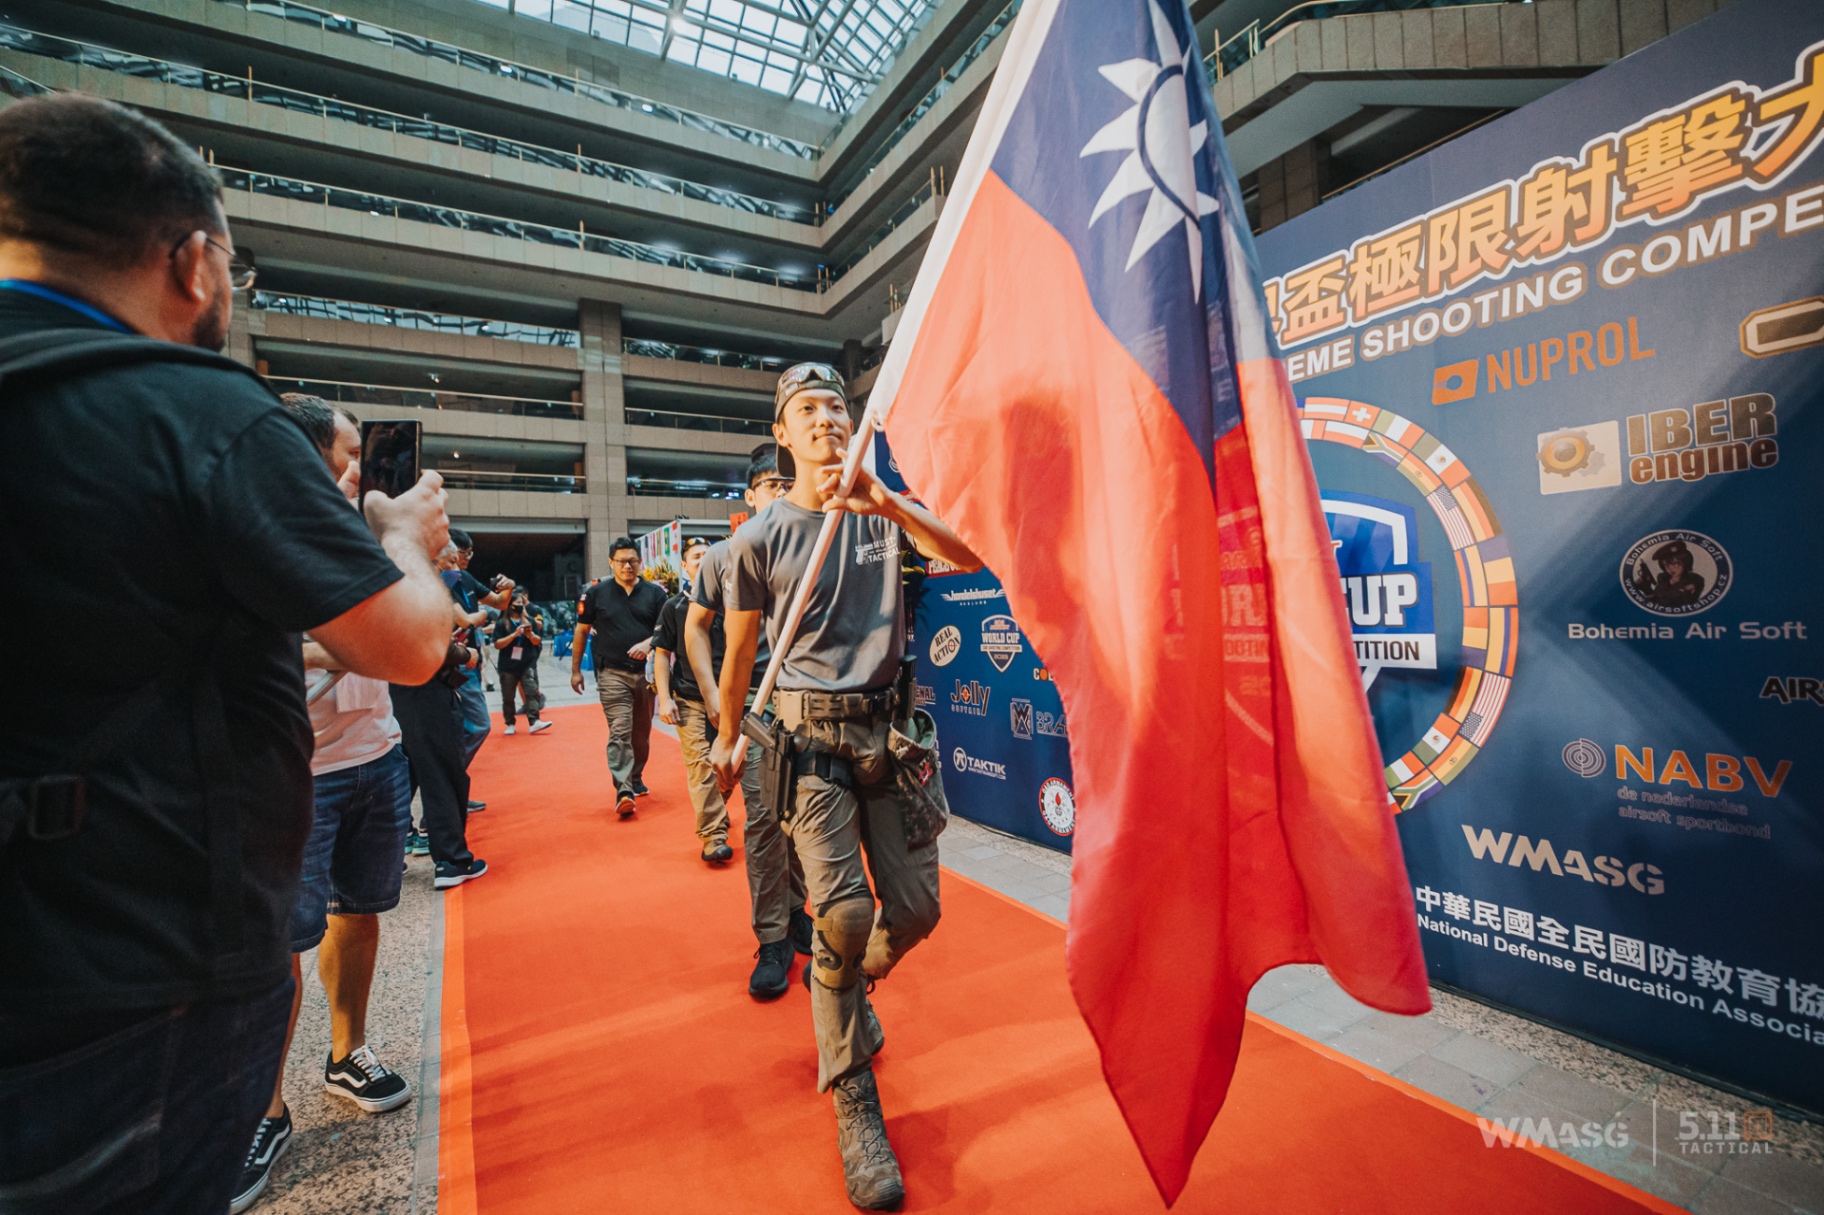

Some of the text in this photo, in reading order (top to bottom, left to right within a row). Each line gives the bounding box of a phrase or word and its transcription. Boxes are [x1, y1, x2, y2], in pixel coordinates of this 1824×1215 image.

[1284, 338, 1352, 382] EME
[1363, 265, 1584, 358] SHOOTING
[1487, 316, 1656, 394] NUPROL
[1626, 392, 1778, 458] IBER
[1629, 438, 1780, 485] engine
[1626, 533, 1724, 566] Bohemia Air Soft
[1340, 572, 1419, 627] UP
[1625, 573, 1728, 613] www.airsoftshop.cz
[934, 627, 954, 648] REAL
[1569, 621, 1808, 640] Bohemia Air Soft
[1354, 640, 1421, 661] TITION
[914, 685, 936, 701] ENAL
[1759, 676, 1824, 706] AIR
[967, 756, 1006, 776] TAKTIK
[1615, 744, 1793, 798] NABV
[1617, 785, 1749, 816] de nederlandse
[1618, 805, 1771, 839] airsoft sportbond
[1461, 824, 1666, 896] WMASG
[1417, 913, 1488, 947] National
[1493, 936, 1577, 972] Defense
[1583, 960, 1705, 1010] Education
